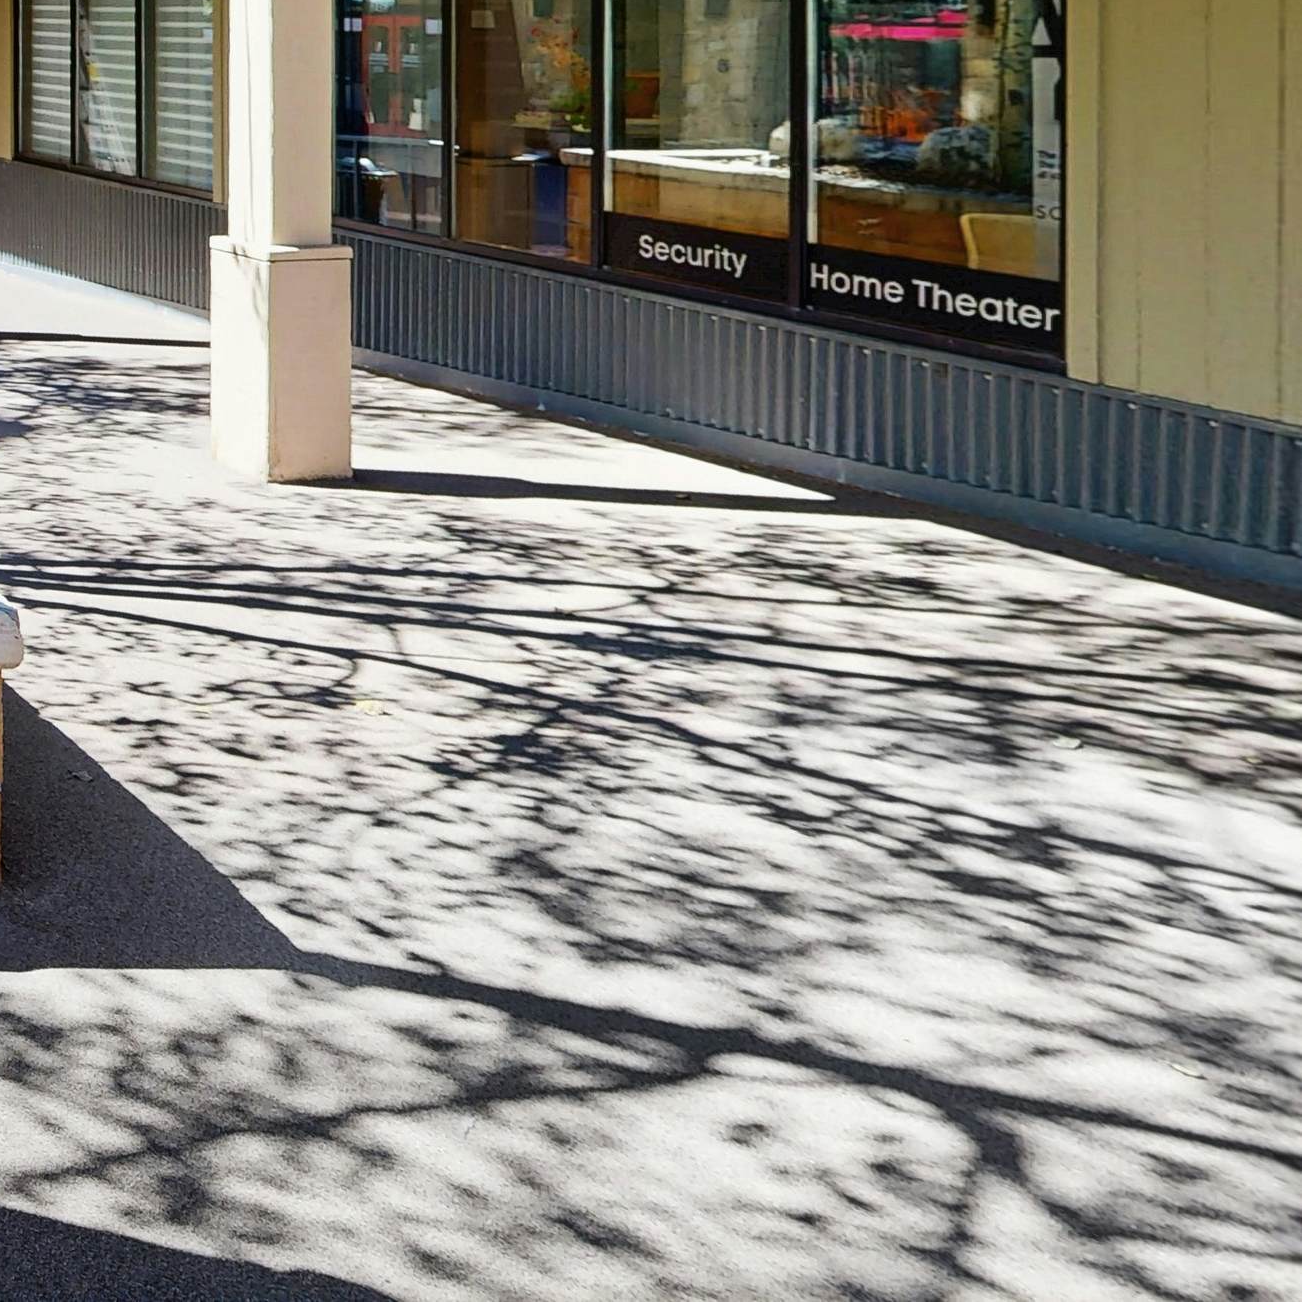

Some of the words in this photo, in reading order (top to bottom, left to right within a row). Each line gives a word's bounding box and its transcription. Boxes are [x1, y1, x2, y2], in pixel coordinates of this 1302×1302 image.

[638, 233, 747, 279] Security
[809, 262, 905, 304] Home
[912, 278, 1060, 332] Theater
